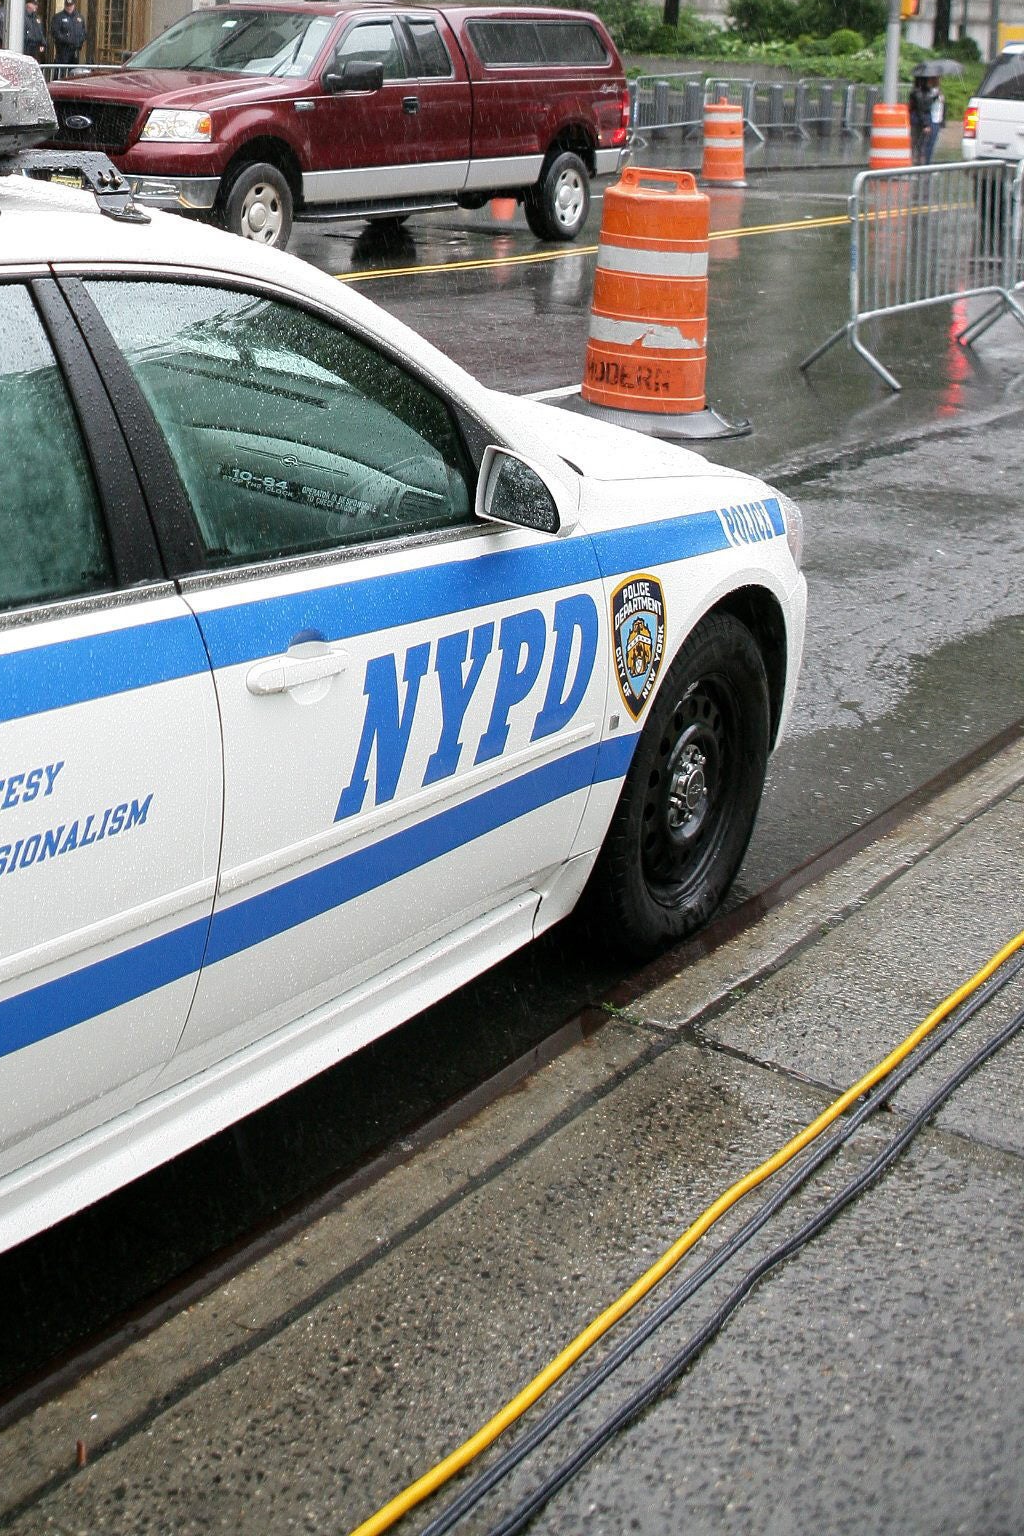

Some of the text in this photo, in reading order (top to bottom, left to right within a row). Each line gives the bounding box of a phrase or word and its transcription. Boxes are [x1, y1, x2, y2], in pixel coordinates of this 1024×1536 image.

[232, 468, 288, 490] 10-84
[720, 501, 774, 547] POLICE
[622, 582, 651, 604] POLICE
[614, 596, 663, 631] DEPARTMENT
[615, 624, 664, 700] CITY OF NEW YORK
[333, 593, 599, 823] NYPD
